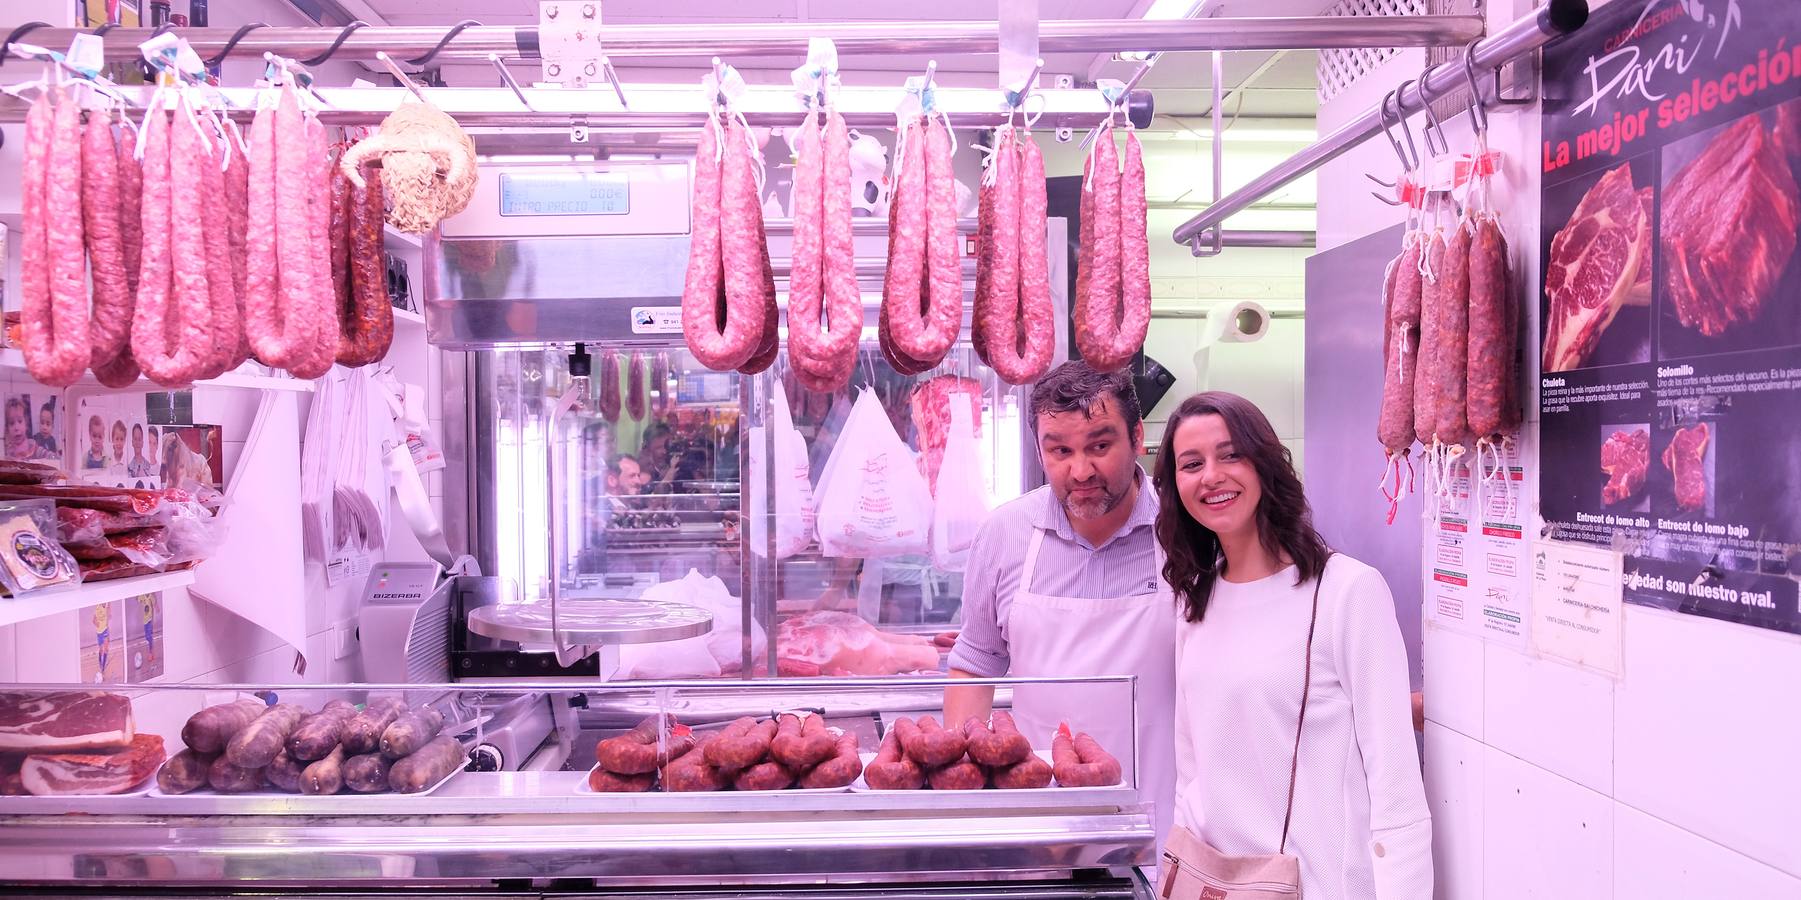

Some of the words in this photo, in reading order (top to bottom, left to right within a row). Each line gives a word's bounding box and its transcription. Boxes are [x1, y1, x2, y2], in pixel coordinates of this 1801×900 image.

[1543, 140, 1570, 172] La
[1576, 107, 1649, 161] mejor
[1657, 365, 1694, 378] Solomillo
[1668, 378, 1675, 387] de
[1682, 377, 1698, 386] cortes
[1699, 374, 1711, 384] más
[1712, 373, 1734, 384] selectos
[1735, 372, 1745, 382] del
[1770, 369, 1779, 379] Es
[1779, 369, 1786, 378] la
[1542, 377, 1566, 388] Chuleta
[1584, 384, 1605, 394] importante
[1682, 387, 1688, 396] de
[1689, 387, 1695, 395] la
[1706, 382, 1747, 394] Recomendado
[1748, 380, 1792, 393] especialmente
[1576, 511, 1605, 524] Entrecot
[1605, 514, 1615, 525] de
[1616, 515, 1634, 527] lomo
[1635, 517, 1650, 528] alto
[1657, 518, 1691, 532] Entrecot
[1692, 521, 1704, 533] de
[1704, 522, 1726, 535] lomo
[1727, 524, 1750, 539] bajo
[1665, 580, 1686, 594] son
[1688, 583, 1738, 601] nuestro
[1740, 590, 1776, 609] aval.
